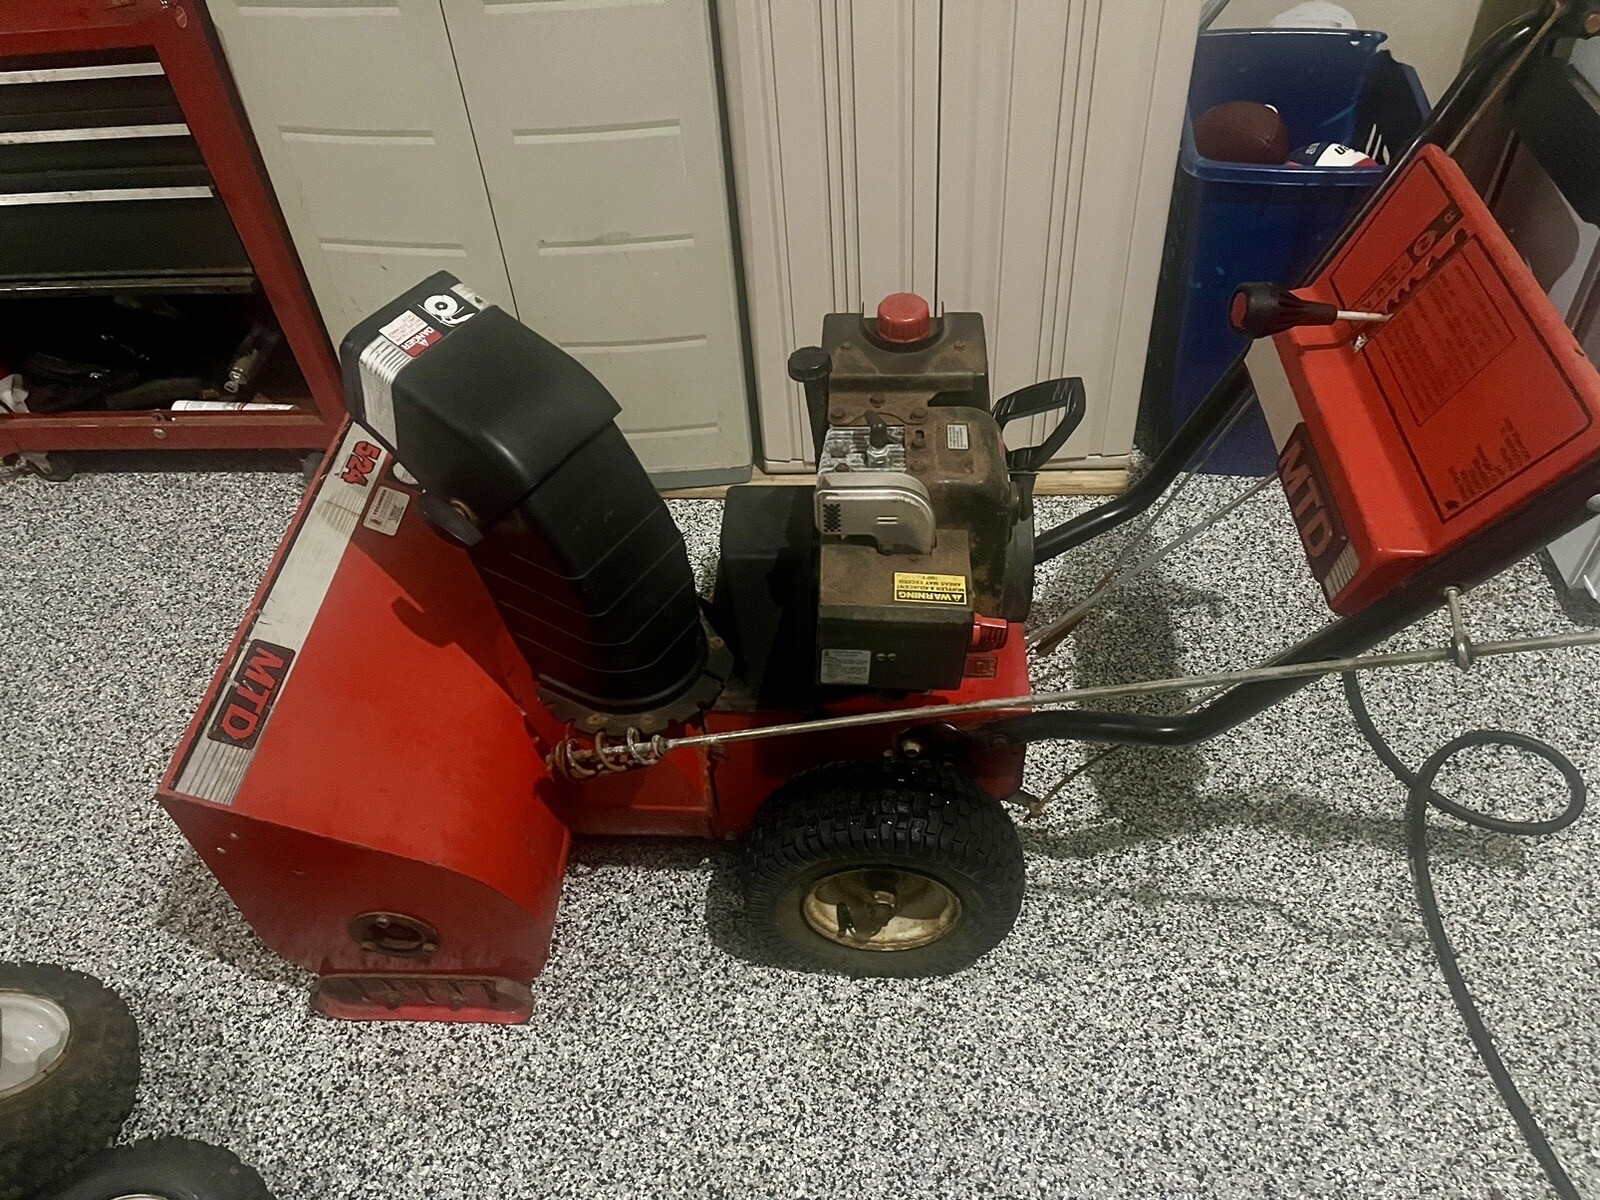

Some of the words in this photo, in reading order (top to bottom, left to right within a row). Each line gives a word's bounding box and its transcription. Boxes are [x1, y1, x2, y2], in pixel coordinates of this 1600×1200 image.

[400, 325, 435, 351] DANGER
[1278, 441, 1333, 558] MTD
[898, 591, 952, 601] WARNING
[222, 646, 284, 740] MTD
